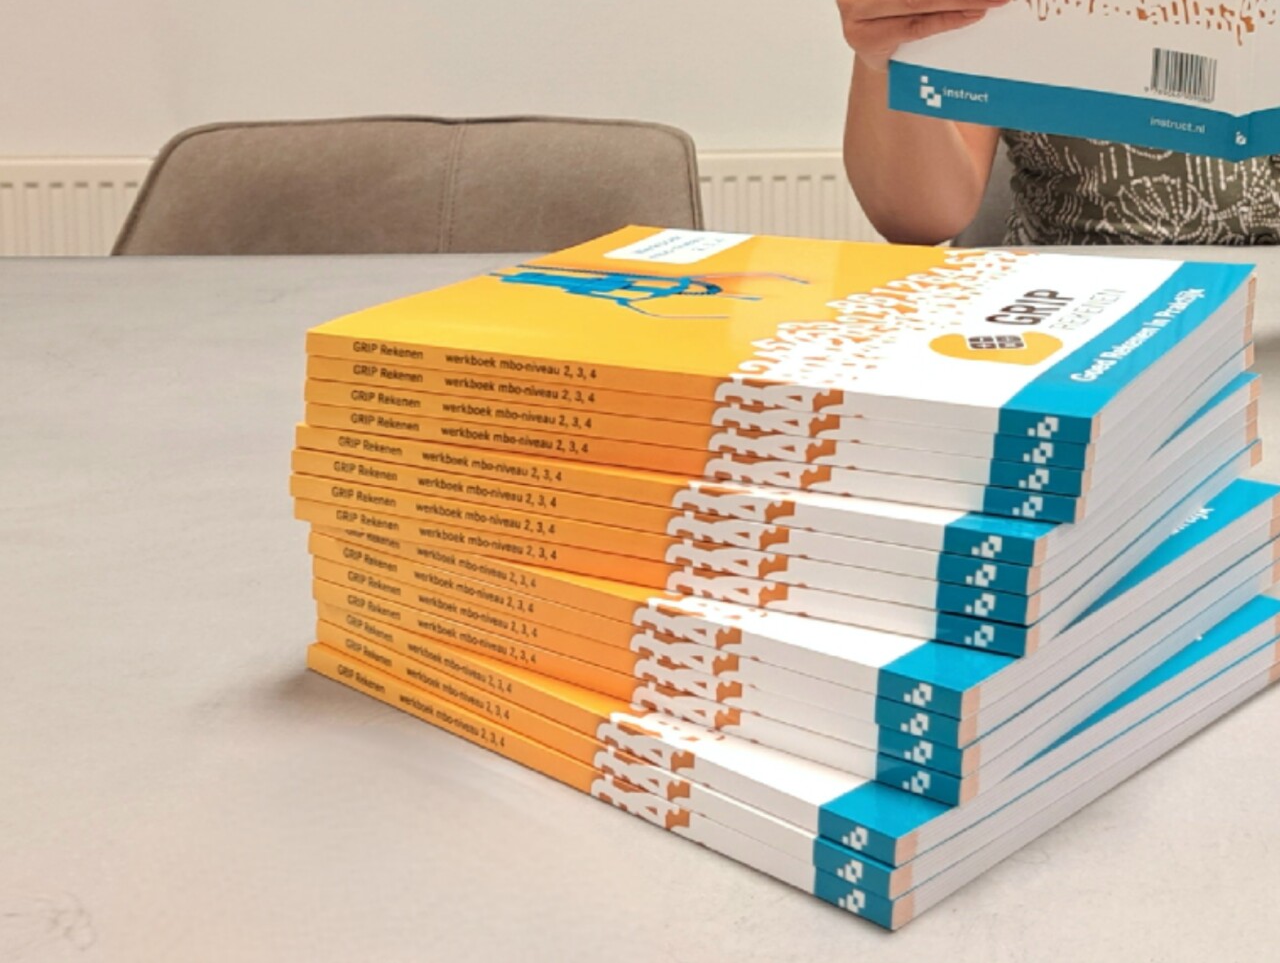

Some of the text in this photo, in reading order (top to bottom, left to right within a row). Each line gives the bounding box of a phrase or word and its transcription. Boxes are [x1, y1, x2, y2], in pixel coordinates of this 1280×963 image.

[943, 86, 989, 103] instruct
[1150, 116, 1205, 134] instruct.nl
[985, 288, 1074, 327] GRIP
[1070, 358, 1118, 382] Goed
[1099, 327, 1161, 360] Rekenen
[1153, 288, 1205, 318] Praktijk
[353, 341, 378, 353] GRIP
[380, 344, 423, 359] Rekenen
[445, 354, 496, 368] werkboek
[500, 360, 560, 375] mbo-niveau
[563, 365, 573, 379] 2,
[590, 369, 597, 379] 4
[353, 364, 378, 376] GRIP
[380, 368, 423, 383] Rekenen
[444, 378, 495, 391] werkboek
[498, 383, 558, 399] mbo-niveau
[561, 389, 571, 402] 2,
[588, 392, 595, 402] 4
[351, 390, 375, 402] GRIP
[378, 393, 421, 408] Rekenen
[442, 403, 492, 416] werkboek
[495, 408, 555, 425] mbo-niveau
[558, 415, 569, 428] 2,
[584, 418, 592, 428] 4
[350, 413, 375, 425] GRIP
[377, 416, 420, 431] Rekenen
[441, 427, 490, 441] werkboek
[493, 433, 553, 449] mbo-niveau
[555, 440, 566, 452] 2,
[581, 443, 588, 453] 4
[338, 436, 361, 448] GRIP
[363, 439, 403, 455] Rekenen
[422, 451, 469, 467] werkboek
[472, 459, 528, 476] mbo-niveau
[531, 467, 540, 480] 2,
[555, 471, 562, 482] 4
[333, 461, 356, 473] GRIP
[358, 464, 398, 481] Rekenen
[418, 478, 464, 492] werkboek
[466, 484, 523, 503] mbo-niveau
[525, 493, 535, 507] 2,
[550, 497, 557, 508] 4
[331, 486, 354, 499] GRIP
[356, 490, 397, 507] Rekenen
[416, 503, 462, 519] werkboek
[465, 511, 521, 530] mbo-niveau
[524, 519, 534, 532] 2,
[549, 523, 555, 533] 4
[336, 509, 358, 521] GRIP
[360, 514, 399, 531] Rekenen
[419, 527, 465, 543] werkboek
[468, 536, 523, 555] mbo-niveau
[526, 545, 536, 558] 2,
[550, 549, 557, 560] 4
